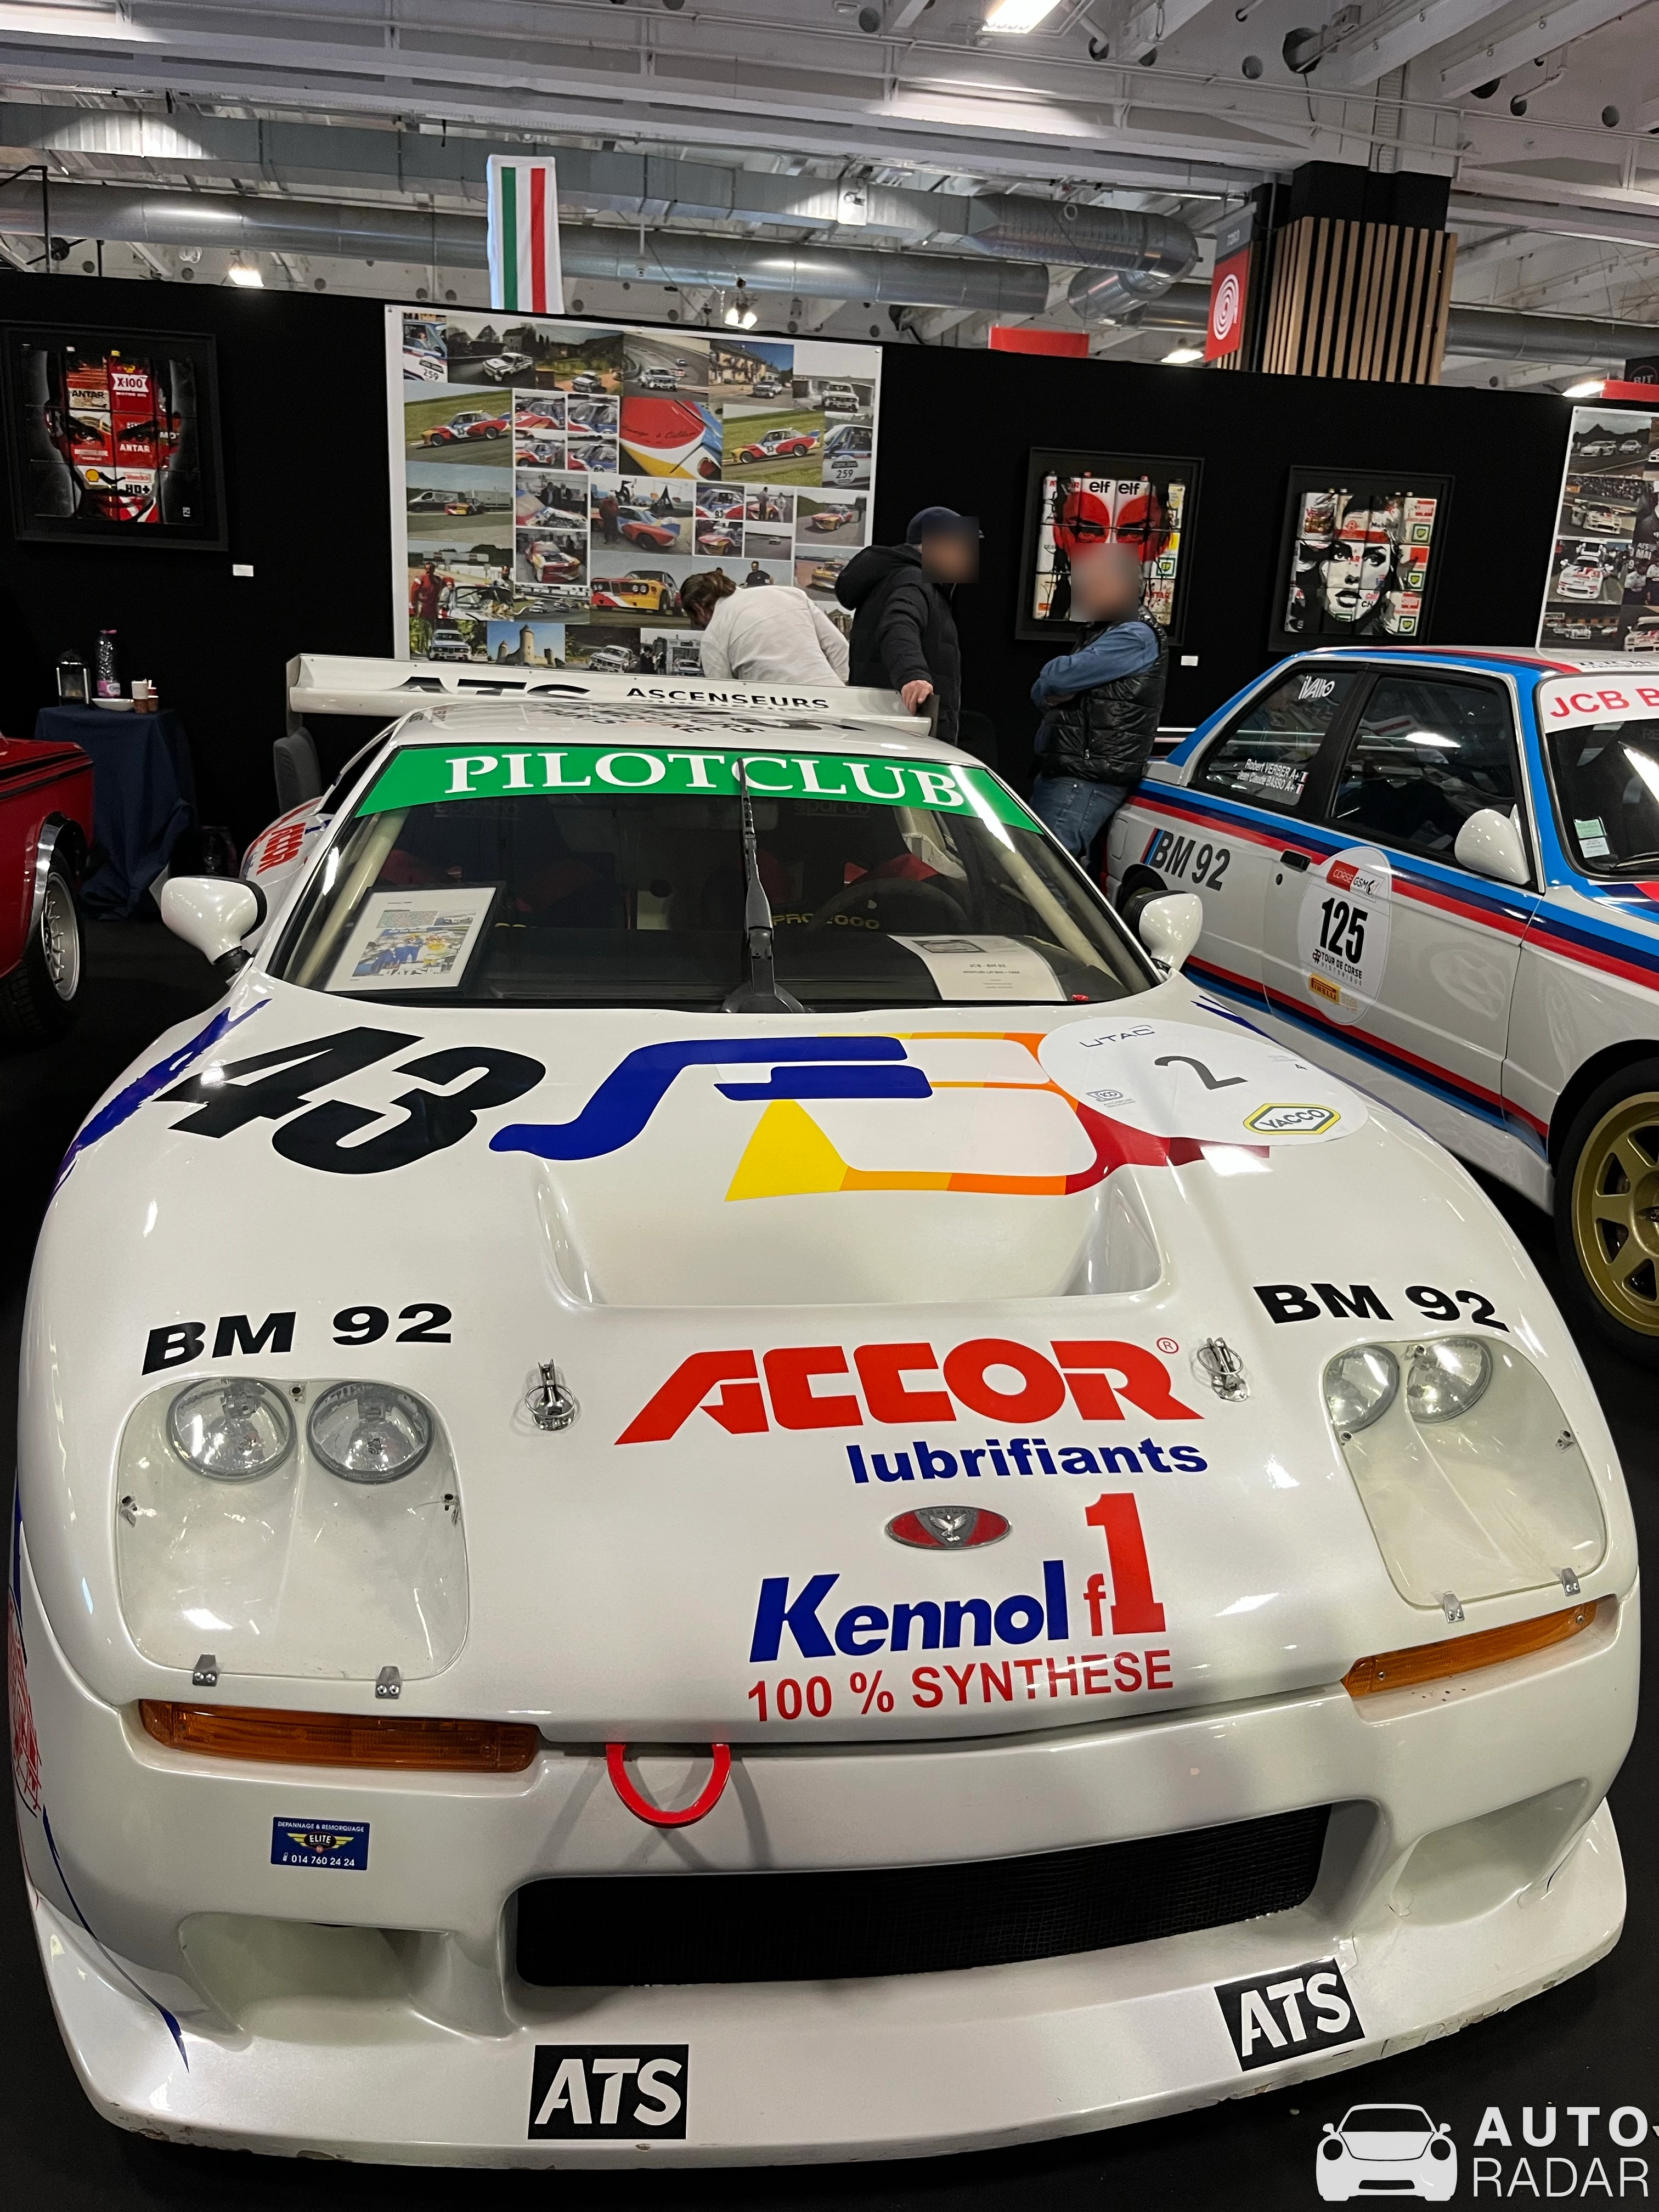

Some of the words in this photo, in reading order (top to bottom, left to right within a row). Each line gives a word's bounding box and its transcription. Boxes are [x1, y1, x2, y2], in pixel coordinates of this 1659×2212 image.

[71, 390, 104, 398] ANTAR
[119, 443, 150, 453] ANTAR
[836, 469, 854, 479] 259
[1089, 481, 1111, 493] elf
[1119, 482, 1141, 495] elf
[626, 687, 829, 709] ASCENSEURS
[1550, 691, 1630, 718] JCB
[1266, 776, 1286, 789] BASSO
[1148, 831, 1197, 878] BM
[1191, 843, 1231, 891] 92
[1333, 869, 1354, 883] CORSE
[826, 915, 880, 930] 000
[1319, 897, 1368, 964] 125
[1322, 951, 1335, 966] TOUR
[1336, 959, 1343, 970] DE
[1344, 963, 1362, 979] CORSE
[1311, 977, 1336, 1001] PIRELLI
[1079, 1025, 1155, 1047] UTAC
[1154, 1056, 1249, 1090] 2
[150, 1025, 546, 1175] 43
[1259, 1109, 1327, 1129] YACCO
[1253, 1283, 1395, 1324] BM
[1405, 1285, 1510, 1333] 92
[142, 1311, 297, 1376] BM
[332, 1302, 452, 1346] 92
[613, 1338, 1206, 1446] ACCOR
[845, 1437, 1209, 1485] lubrifiants
[749, 1559, 1069, 1663] Kennol
[1083, 1493, 1166, 1637] f1
[748, 1675, 832, 1723] 100
[849, 1669, 895, 1716] %
[912, 1649, 1175, 1708] SYNTHESE
[278, 1821, 314, 1829] DEPANNAGE
[321, 1824, 364, 1832] REMORQUAGE
[309, 1835, 331, 1843] ELITE
[291, 1855, 308, 1864] 014
[311, 1856, 328, 1865] 760
[343, 1858, 355, 1866] 24
[1240, 1972, 1351, 2057] ATS
[534, 2058, 682, 2126] ATS
